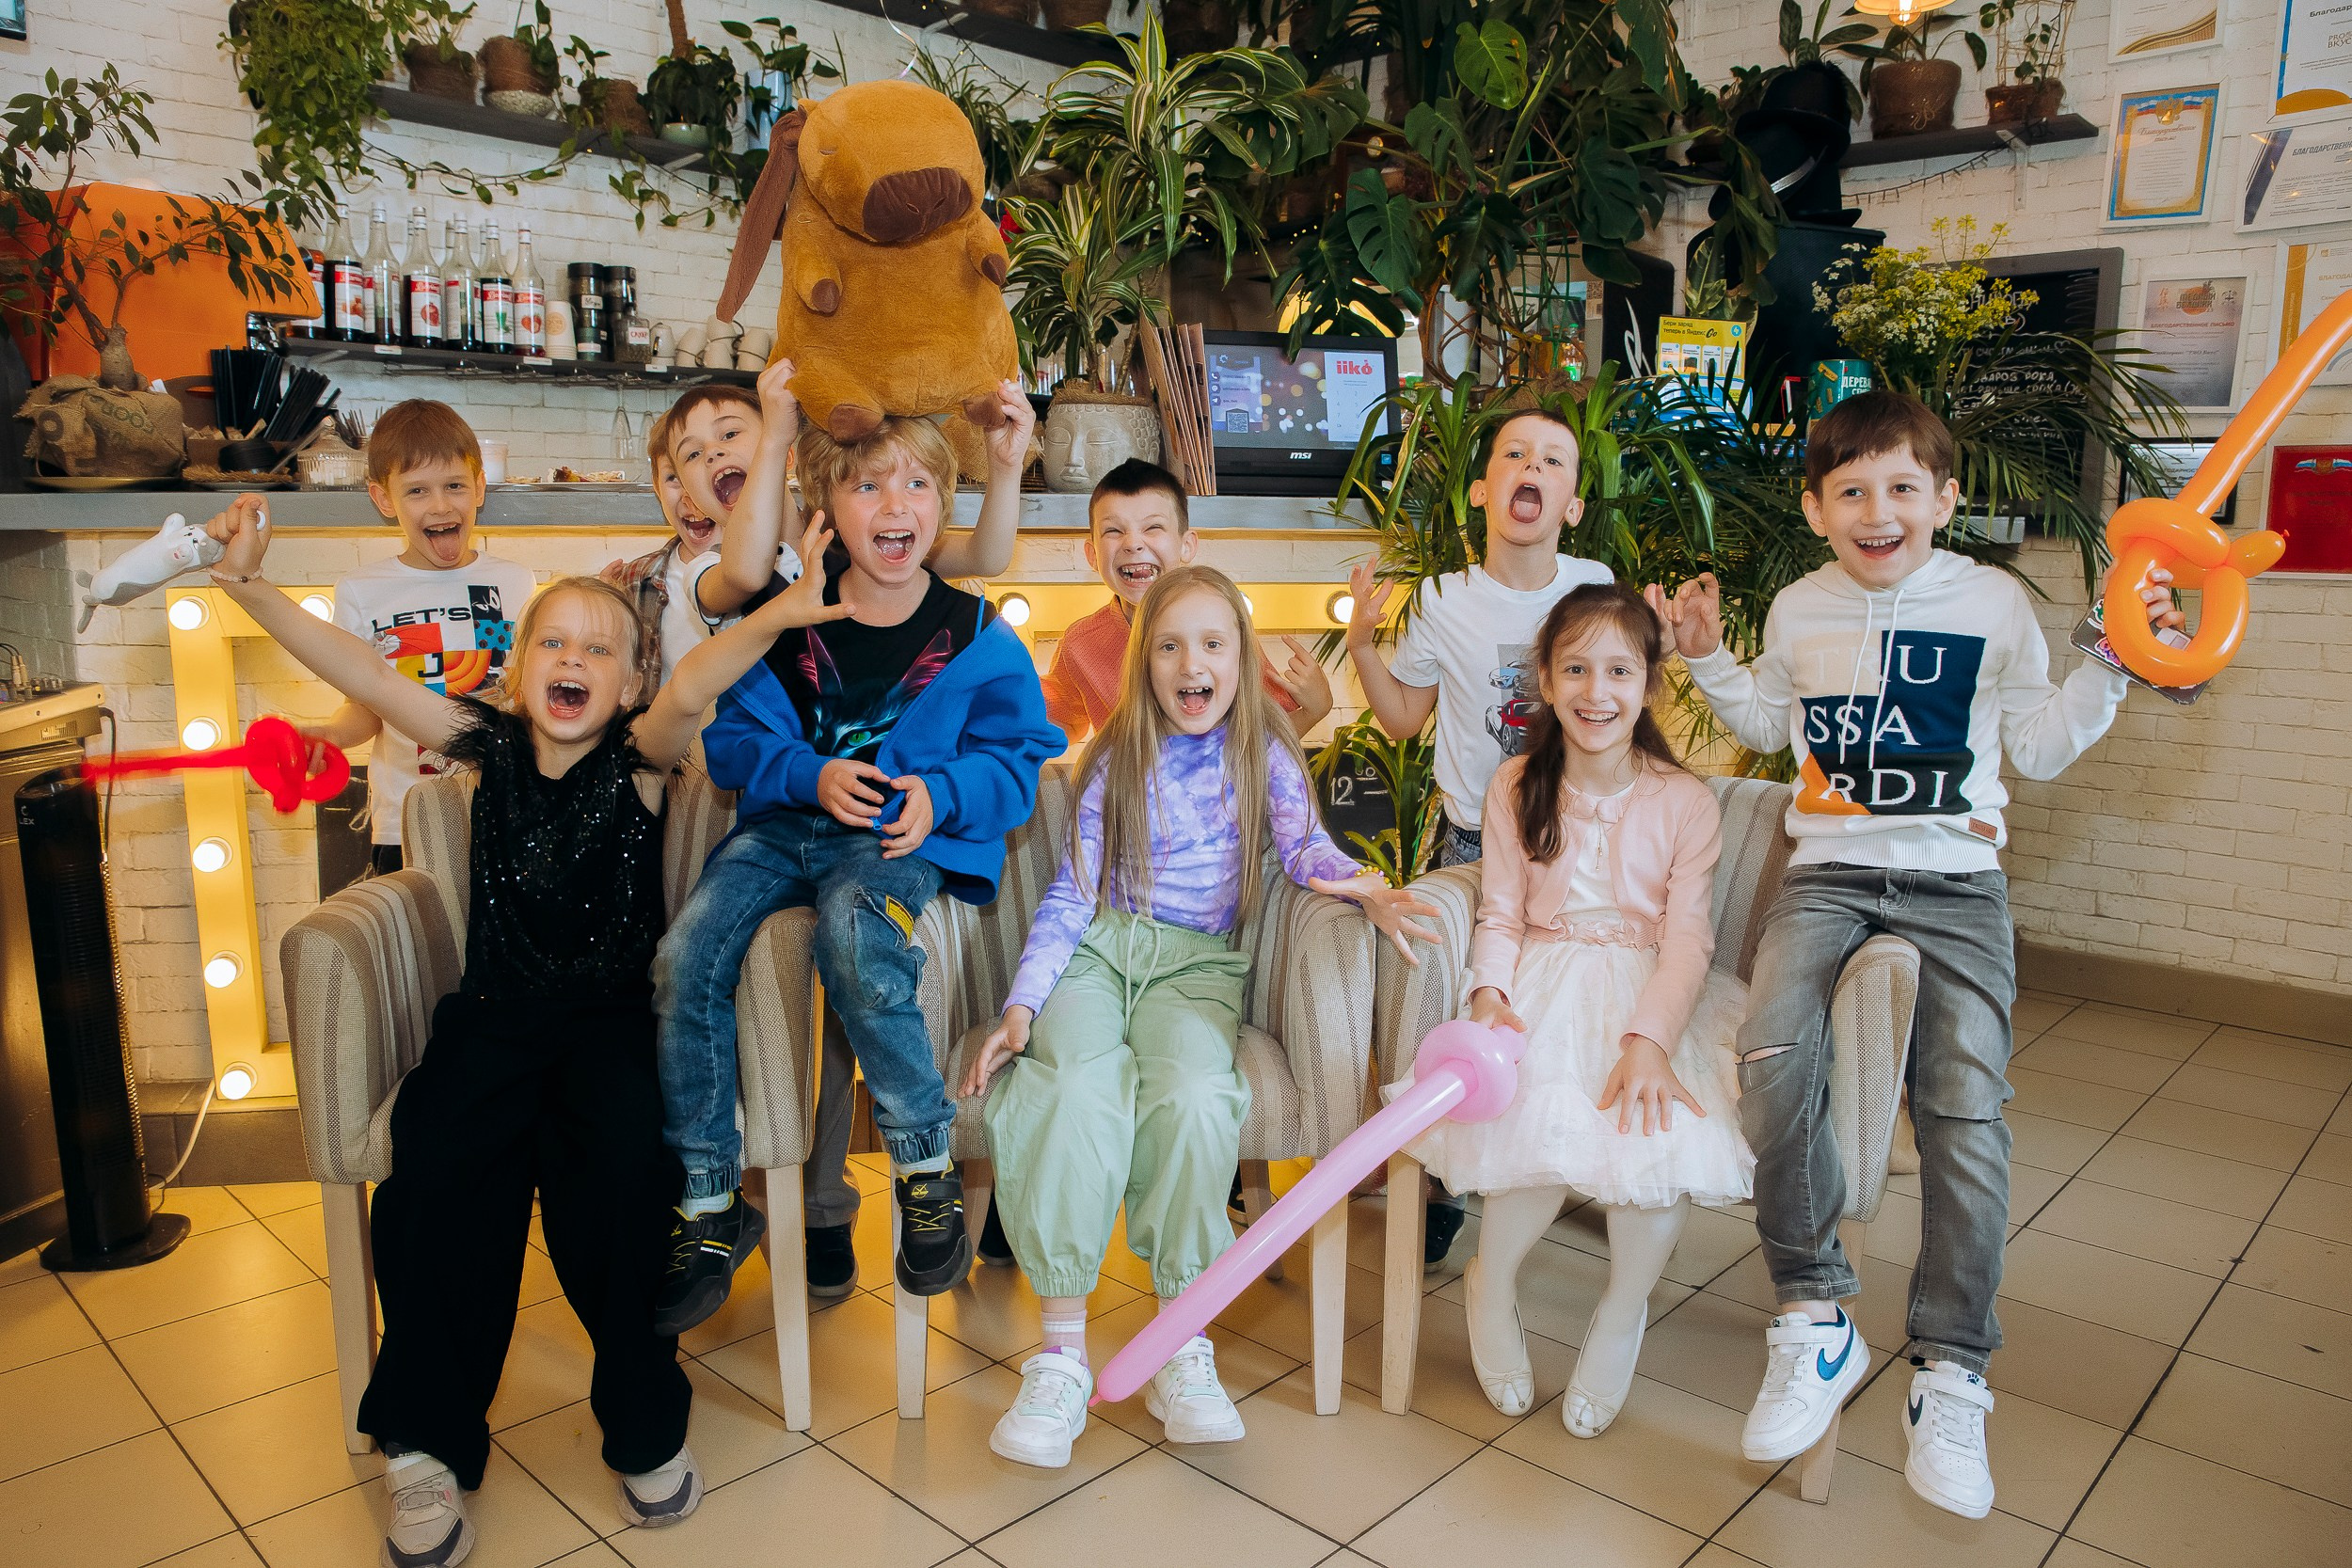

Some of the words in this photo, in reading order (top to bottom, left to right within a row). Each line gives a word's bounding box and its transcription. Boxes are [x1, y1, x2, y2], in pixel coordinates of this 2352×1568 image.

[1706, 327, 1718, 338] Go
[1336, 359, 1374, 375] iiko
[1290, 451, 1312, 460] msi
[372, 607, 473, 633] LET'S
[1806, 705, 1921, 746] SSA
[1816, 768, 1949, 808] RDI
